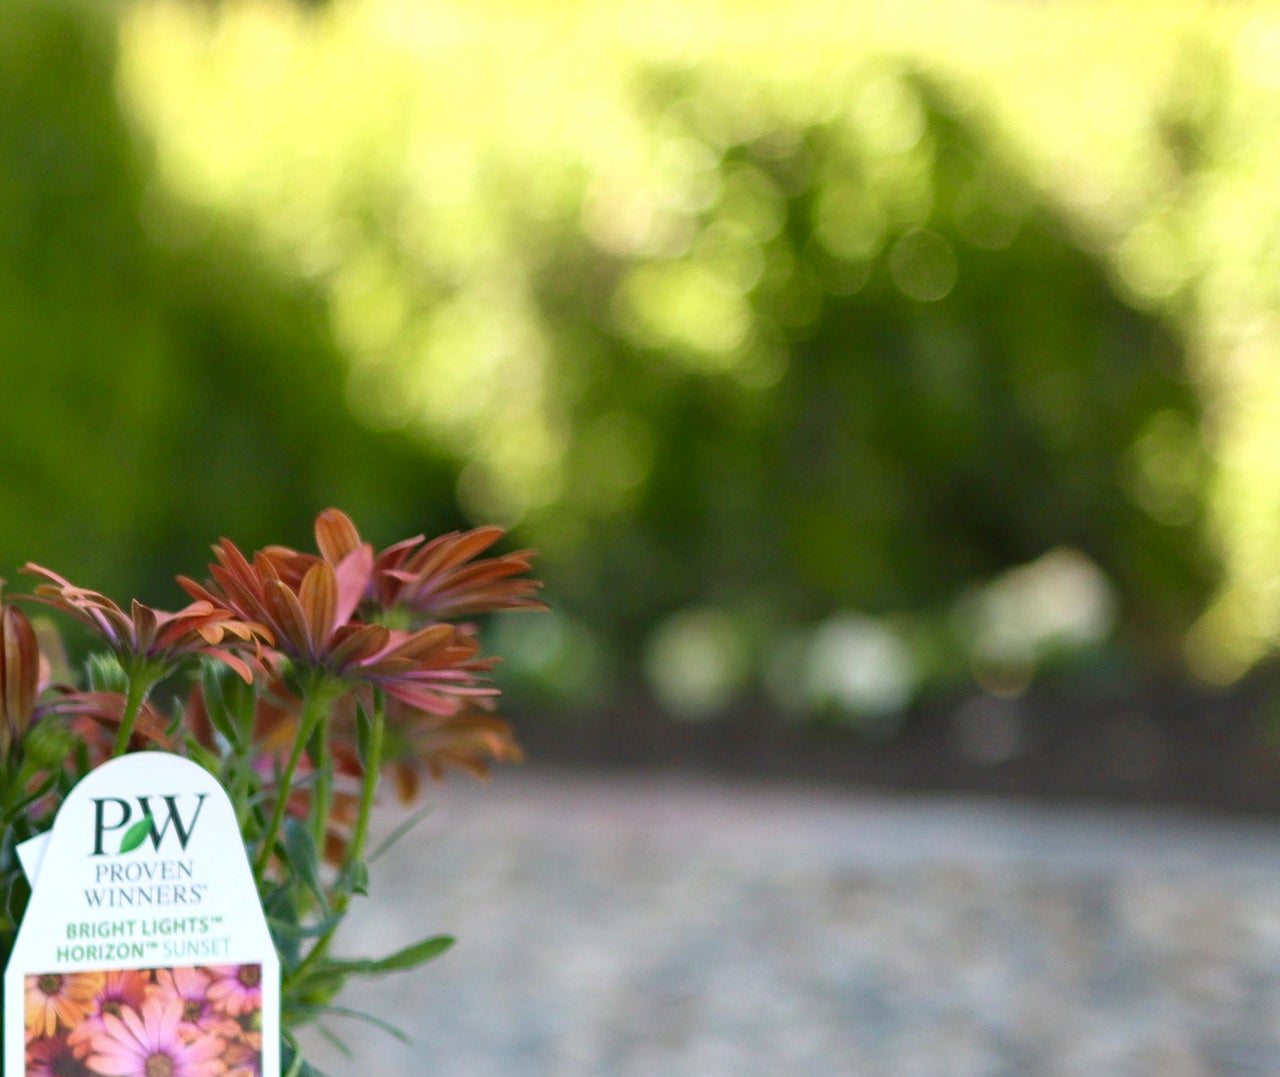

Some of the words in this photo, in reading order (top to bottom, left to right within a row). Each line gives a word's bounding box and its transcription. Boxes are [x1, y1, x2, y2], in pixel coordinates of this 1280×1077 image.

[88, 792, 211, 857] PW
[94, 859, 194, 884] PROVEN
[66, 919, 136, 940] BRIGHT
[162, 937, 232, 959] SUNSET
